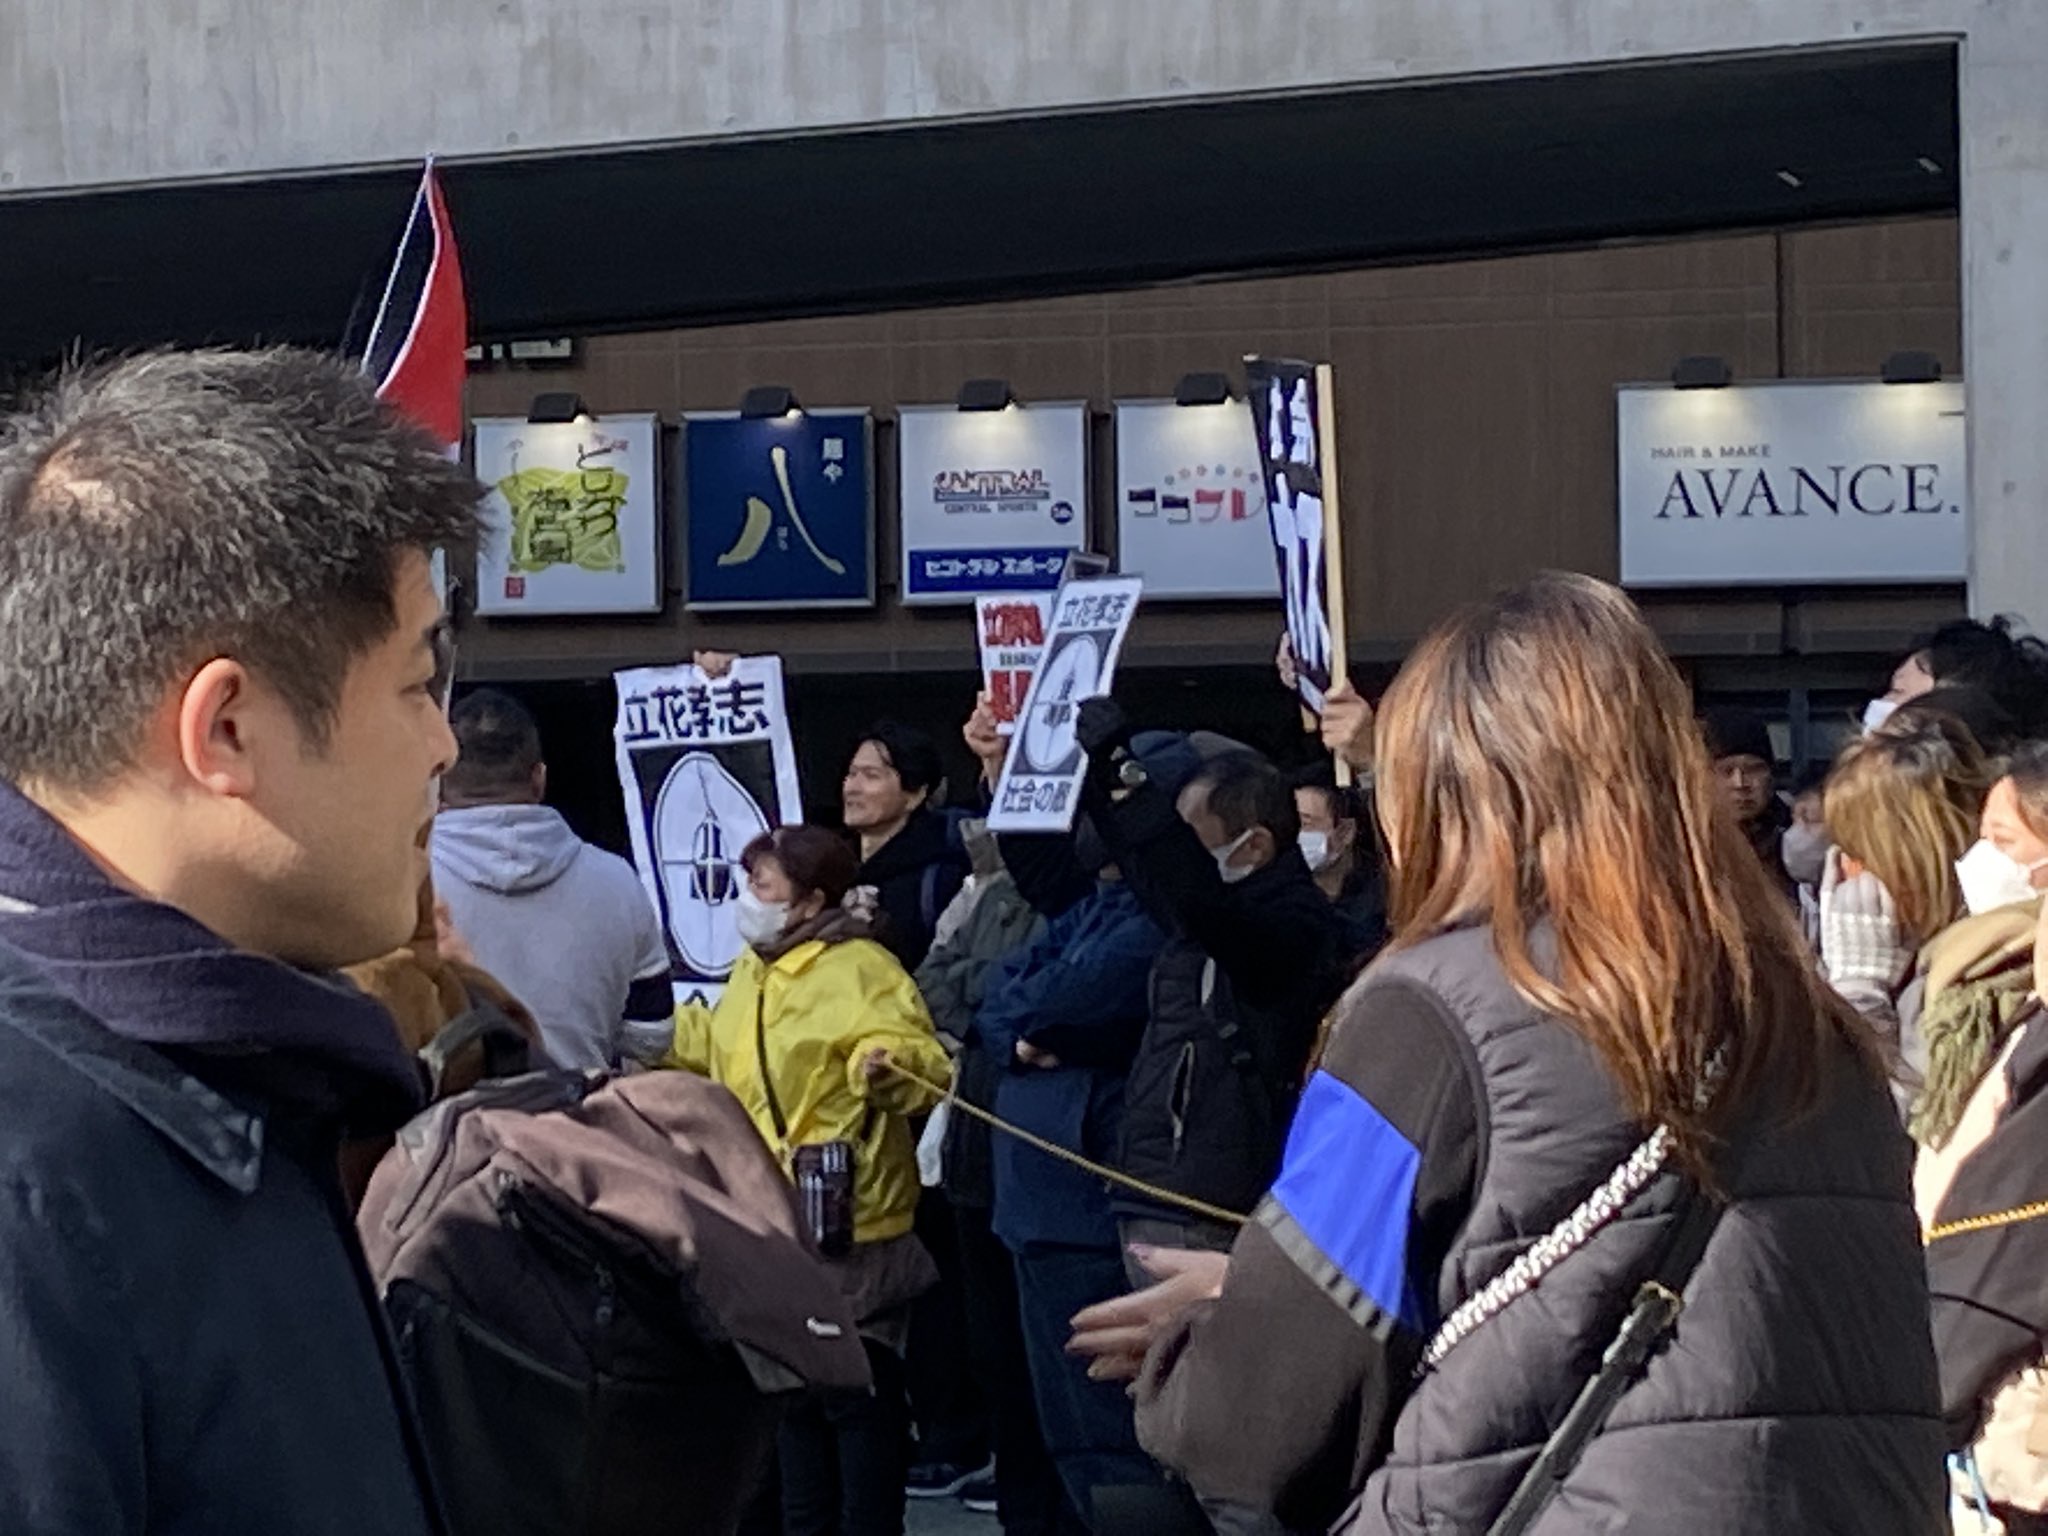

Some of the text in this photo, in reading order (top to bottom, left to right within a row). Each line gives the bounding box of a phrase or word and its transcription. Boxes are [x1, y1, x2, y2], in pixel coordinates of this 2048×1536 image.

[1651, 443, 1771, 459] HAIR & MAKE
[1653, 464, 1960, 519] AVANCE.
[623, 679, 770, 742] 立花孝志
